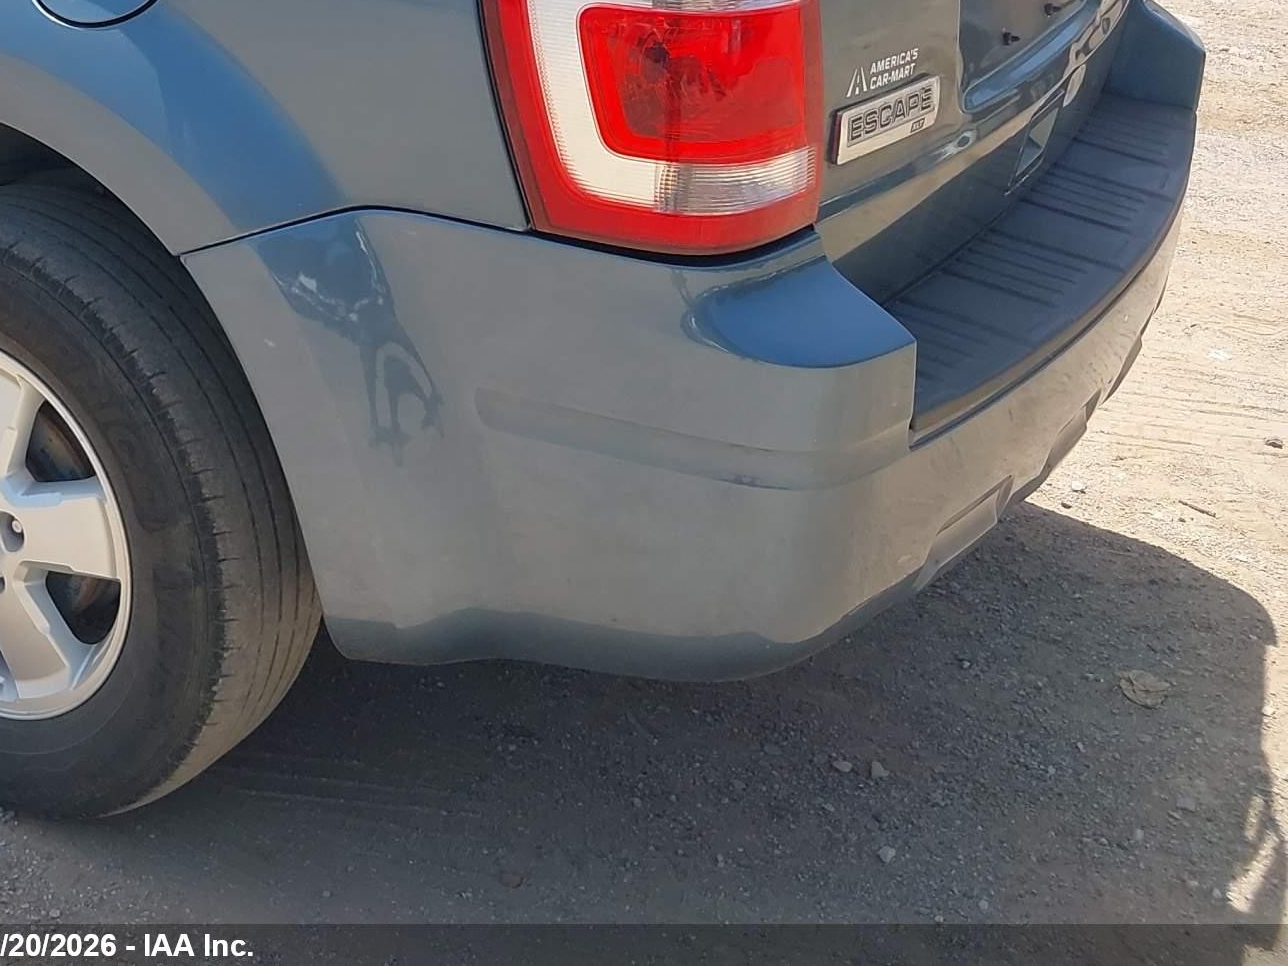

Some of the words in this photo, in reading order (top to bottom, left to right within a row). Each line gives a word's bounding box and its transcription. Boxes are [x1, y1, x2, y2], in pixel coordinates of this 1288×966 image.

[869, 48, 919, 75] AMERICA'S
[869, 63, 916, 90] CAR-MART
[849, 85, 934, 142] ESCAPE
